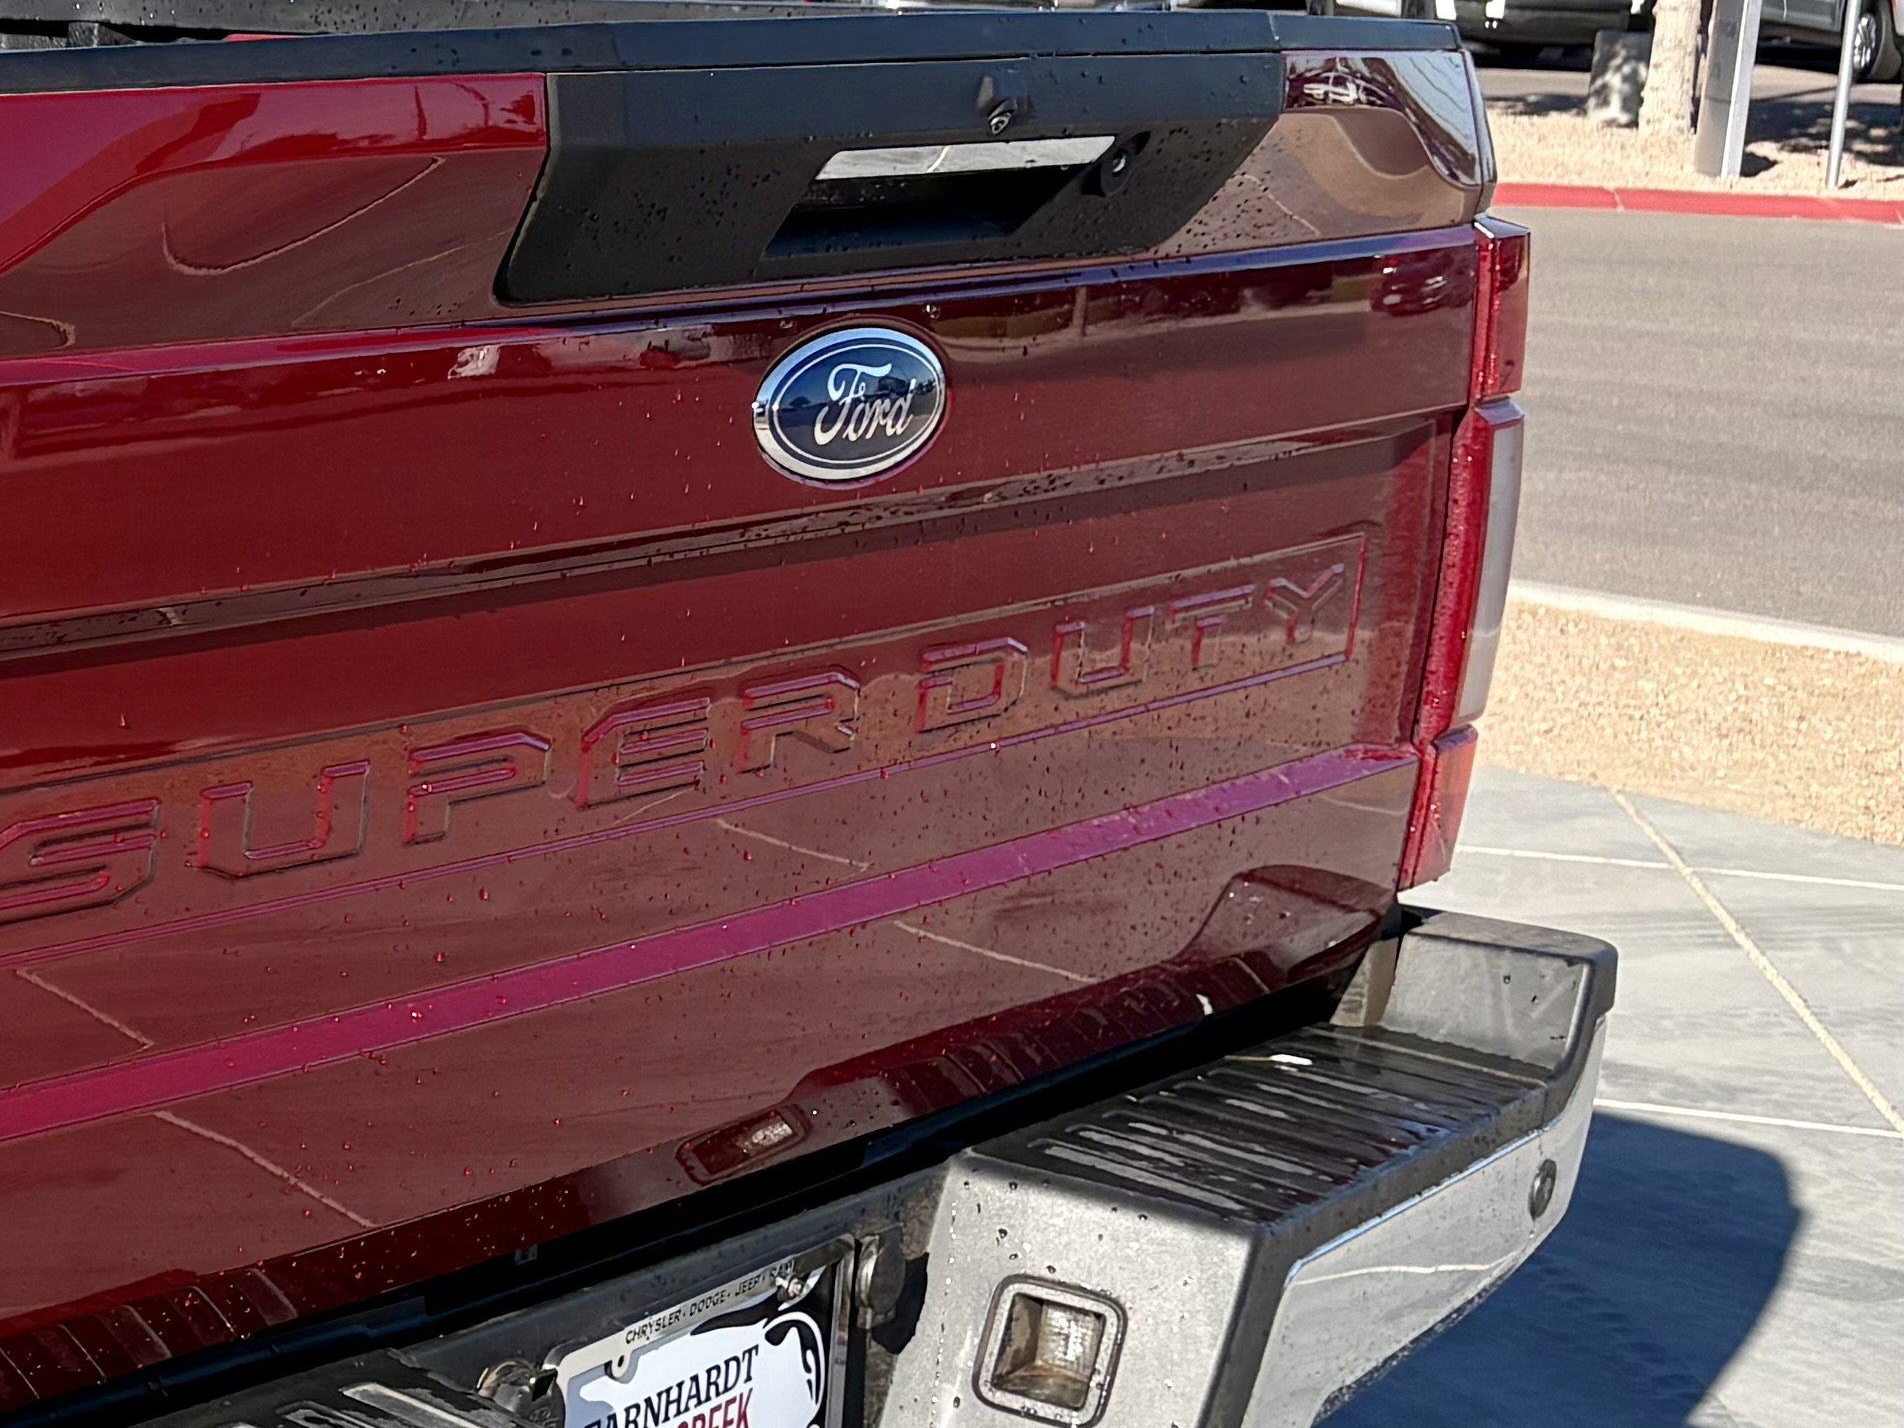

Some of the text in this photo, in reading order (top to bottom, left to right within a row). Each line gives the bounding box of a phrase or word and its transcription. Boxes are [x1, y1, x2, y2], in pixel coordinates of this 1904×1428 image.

[814, 362, 917, 445] Ford
[914, 563, 1346, 733] DUTY
[625, 1309, 682, 1345] CHRYSLER
[689, 1288, 727, 1318] DODGE
[734, 1274, 761, 1297] JEEP
